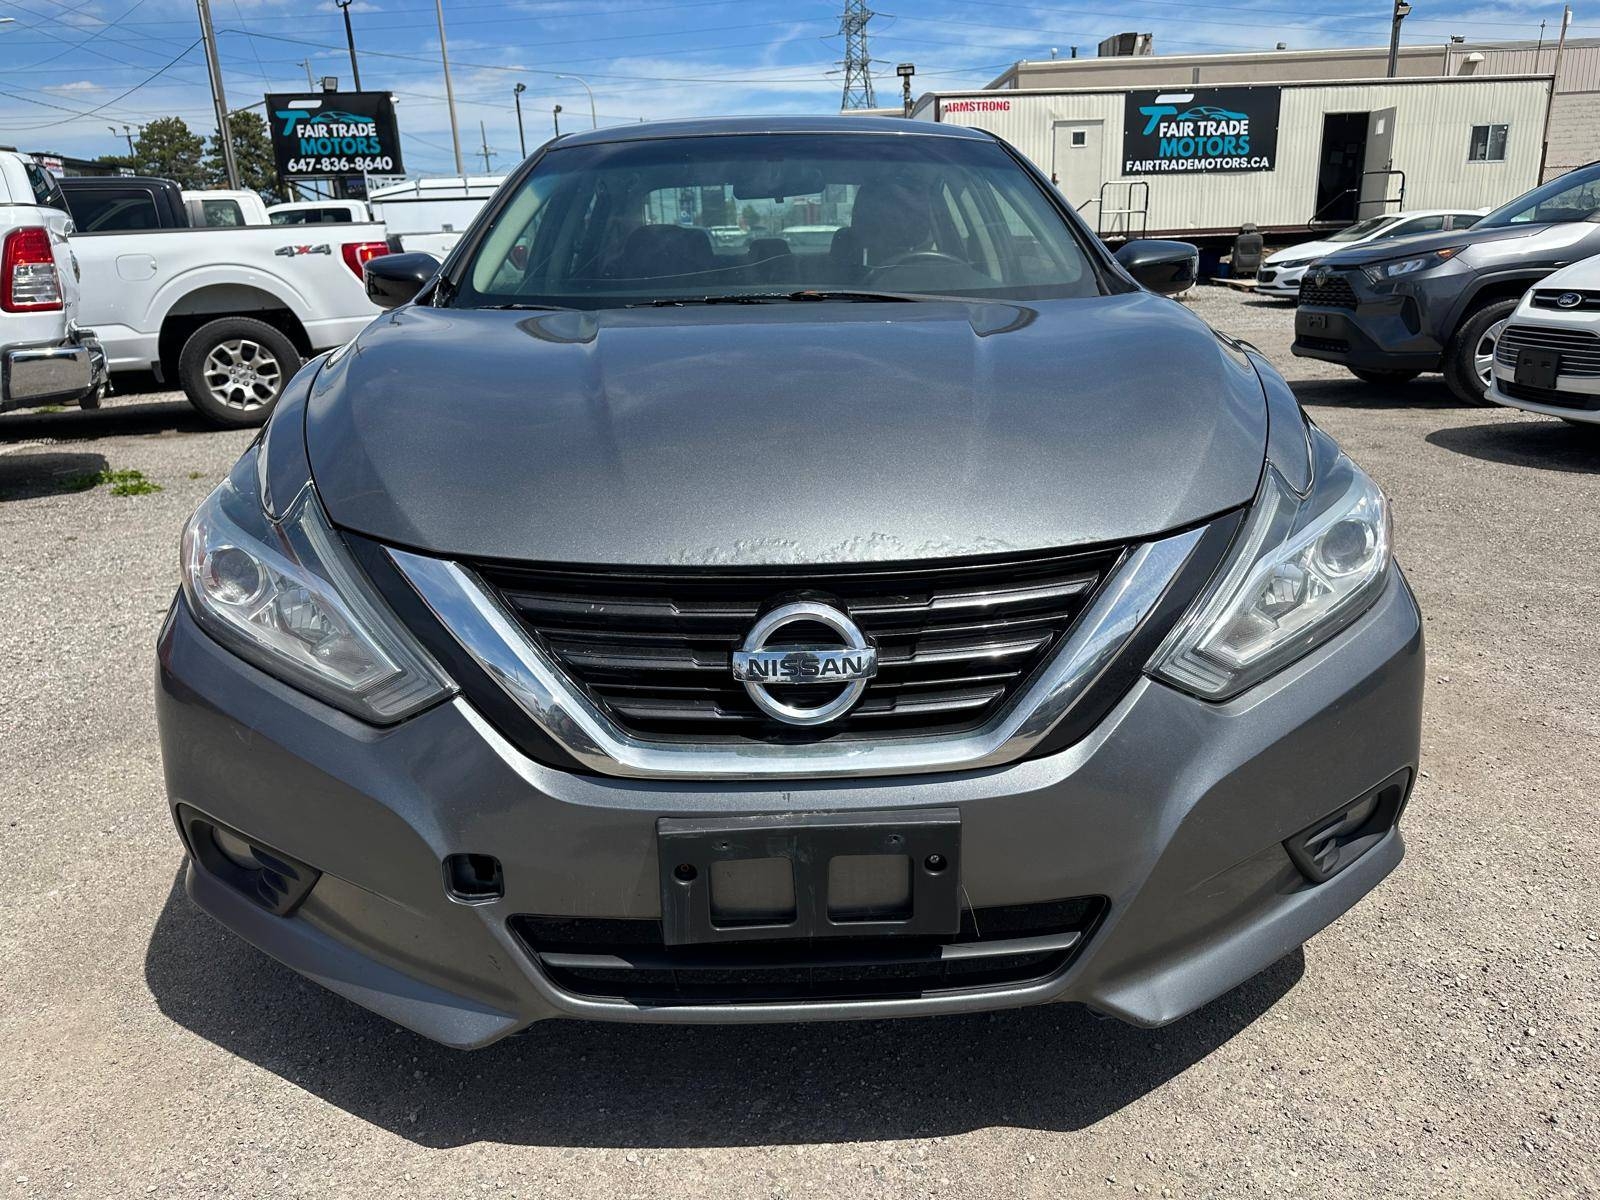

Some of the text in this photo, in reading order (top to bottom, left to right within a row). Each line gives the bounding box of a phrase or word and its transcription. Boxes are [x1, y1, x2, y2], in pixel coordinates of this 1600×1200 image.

[945, 101, 1010, 112] ARMSTRONG
[296, 123, 377, 138] FAIR TRADE
[1159, 120, 1249, 137] FAIR TRADE
[300, 137, 382, 155] MOTORS
[1159, 136, 1250, 158] MOTORS
[287, 156, 393, 172] 647-836-8640
[1126, 157, 1269, 172] FAIRTRADEMOTORS.CA
[748, 656, 862, 677] NISSAN
